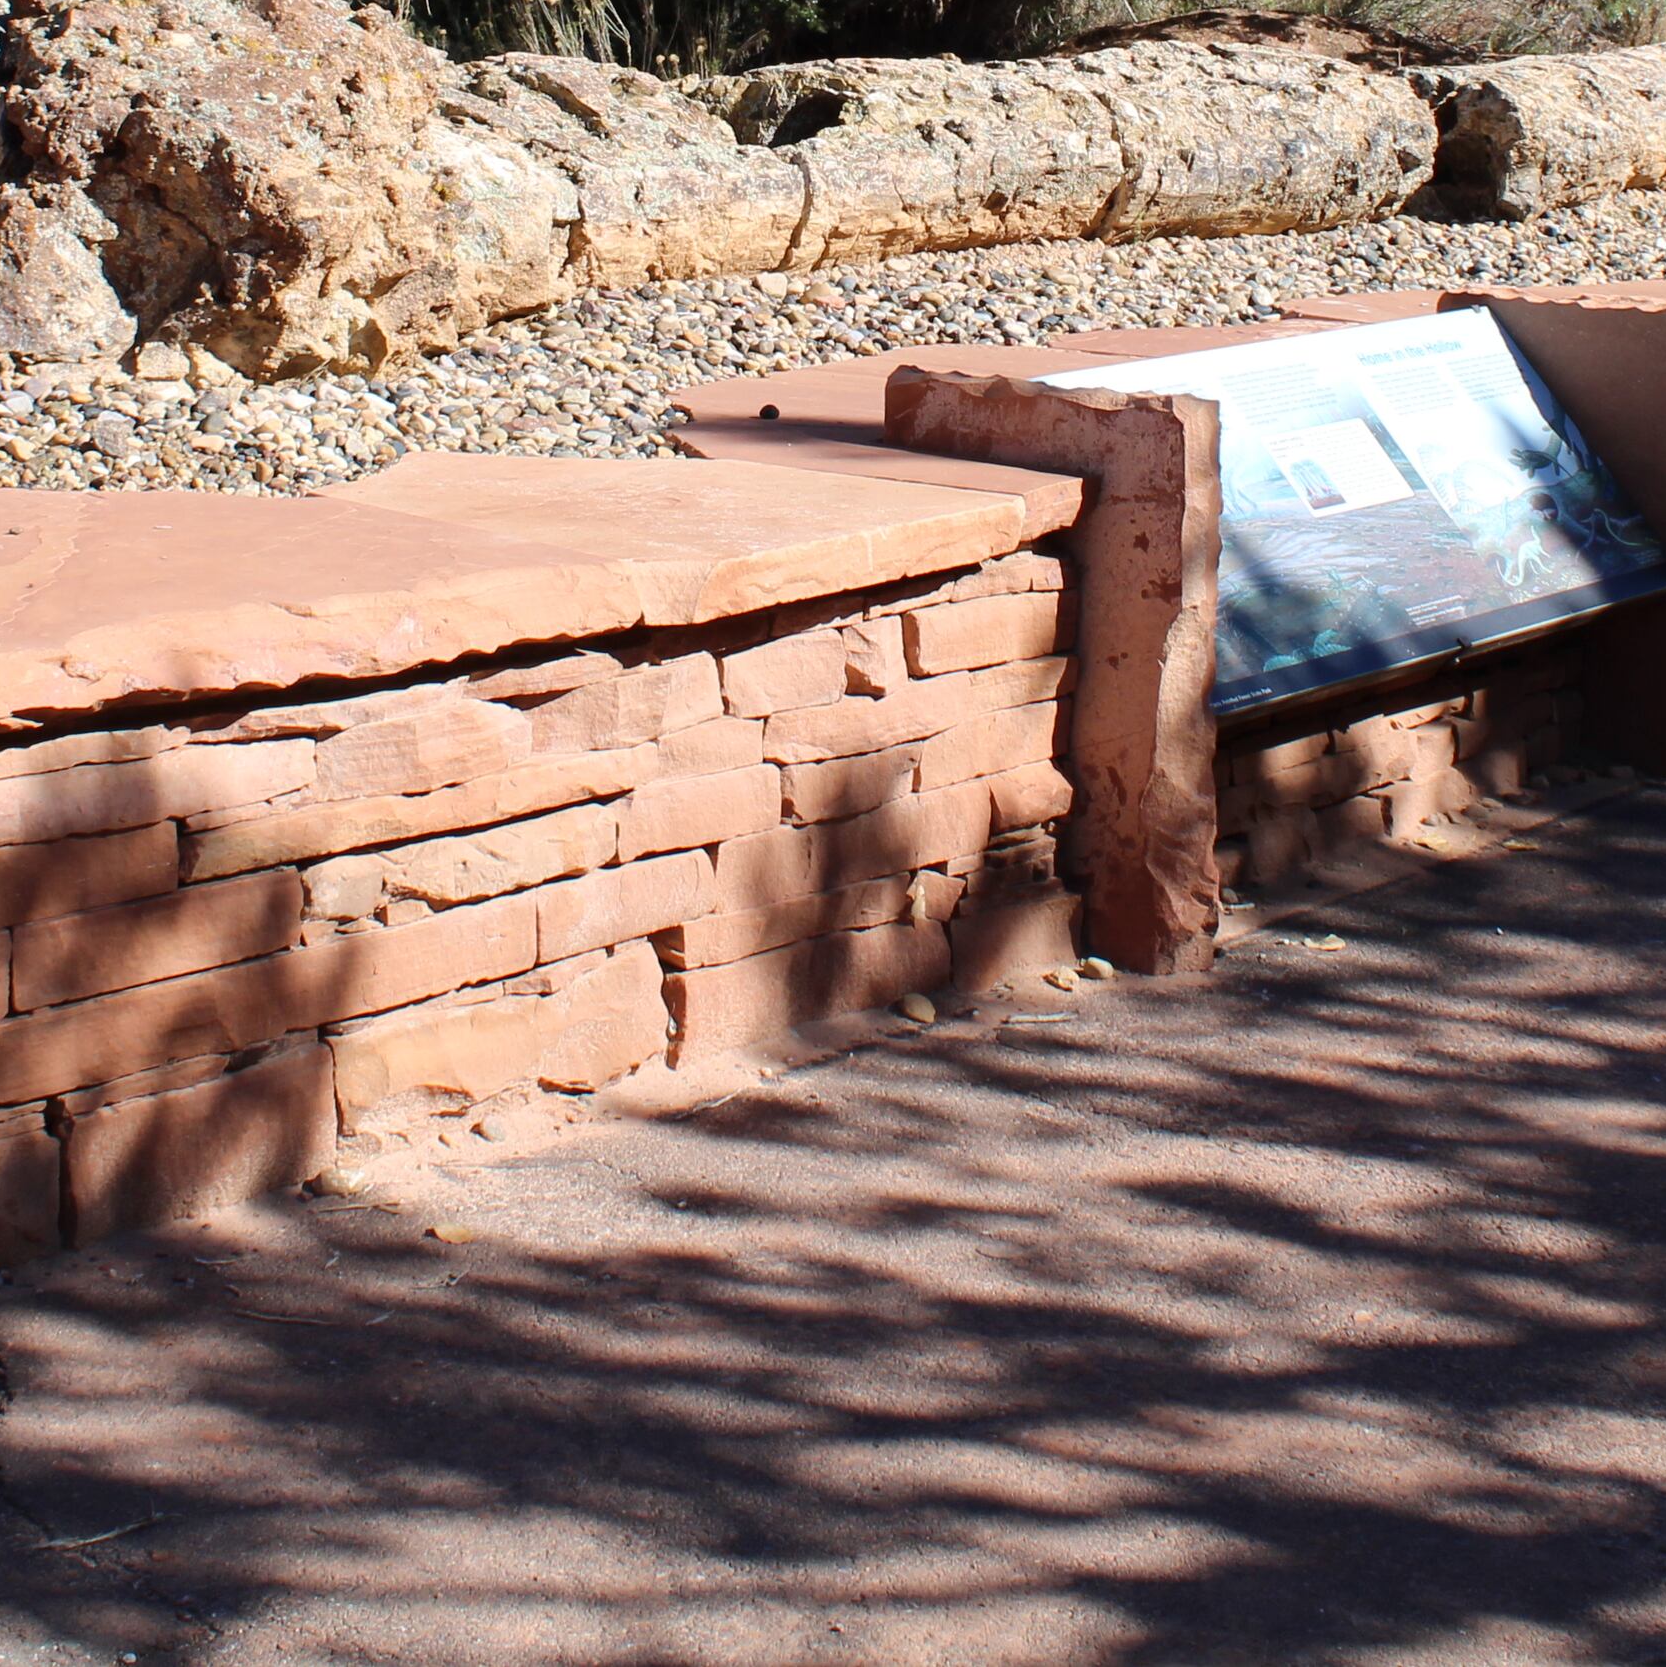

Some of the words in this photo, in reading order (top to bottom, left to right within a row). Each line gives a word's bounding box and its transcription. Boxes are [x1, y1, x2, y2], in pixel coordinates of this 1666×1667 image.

[1357, 352, 1392, 366] Home
[1393, 347, 1405, 360] in
[1404, 344, 1425, 358] the
[1423, 340, 1463, 354] Hollow
